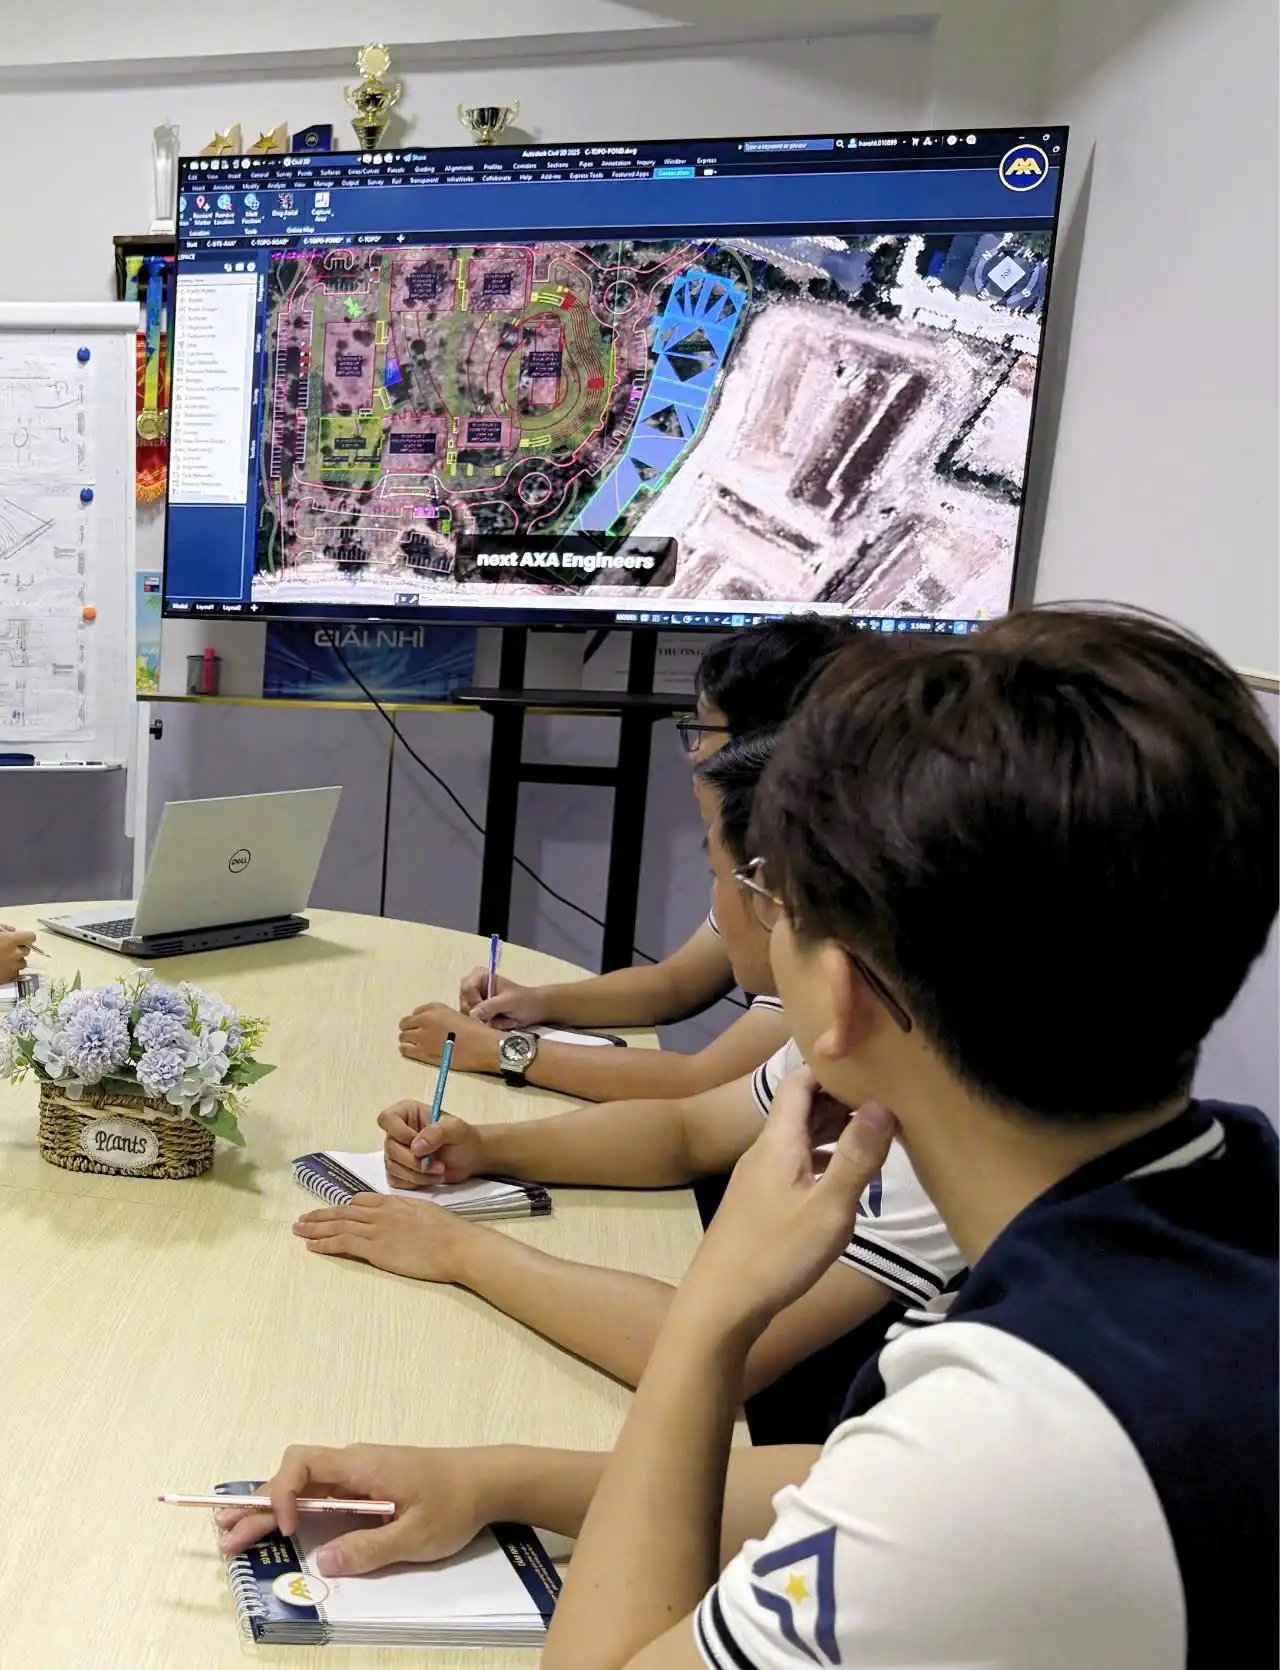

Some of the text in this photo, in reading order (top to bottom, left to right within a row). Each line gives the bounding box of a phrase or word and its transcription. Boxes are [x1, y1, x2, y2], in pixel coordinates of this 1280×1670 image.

[1000, 268, 1012, 280] TOP
[1022, 288, 1032, 298] S
[476, 552, 655, 572] next AXA Engineers
[376, 626, 425, 648] NHÌ
[232, 858, 247, 866] DELL
[95, 1130, 147, 1154] Plants
